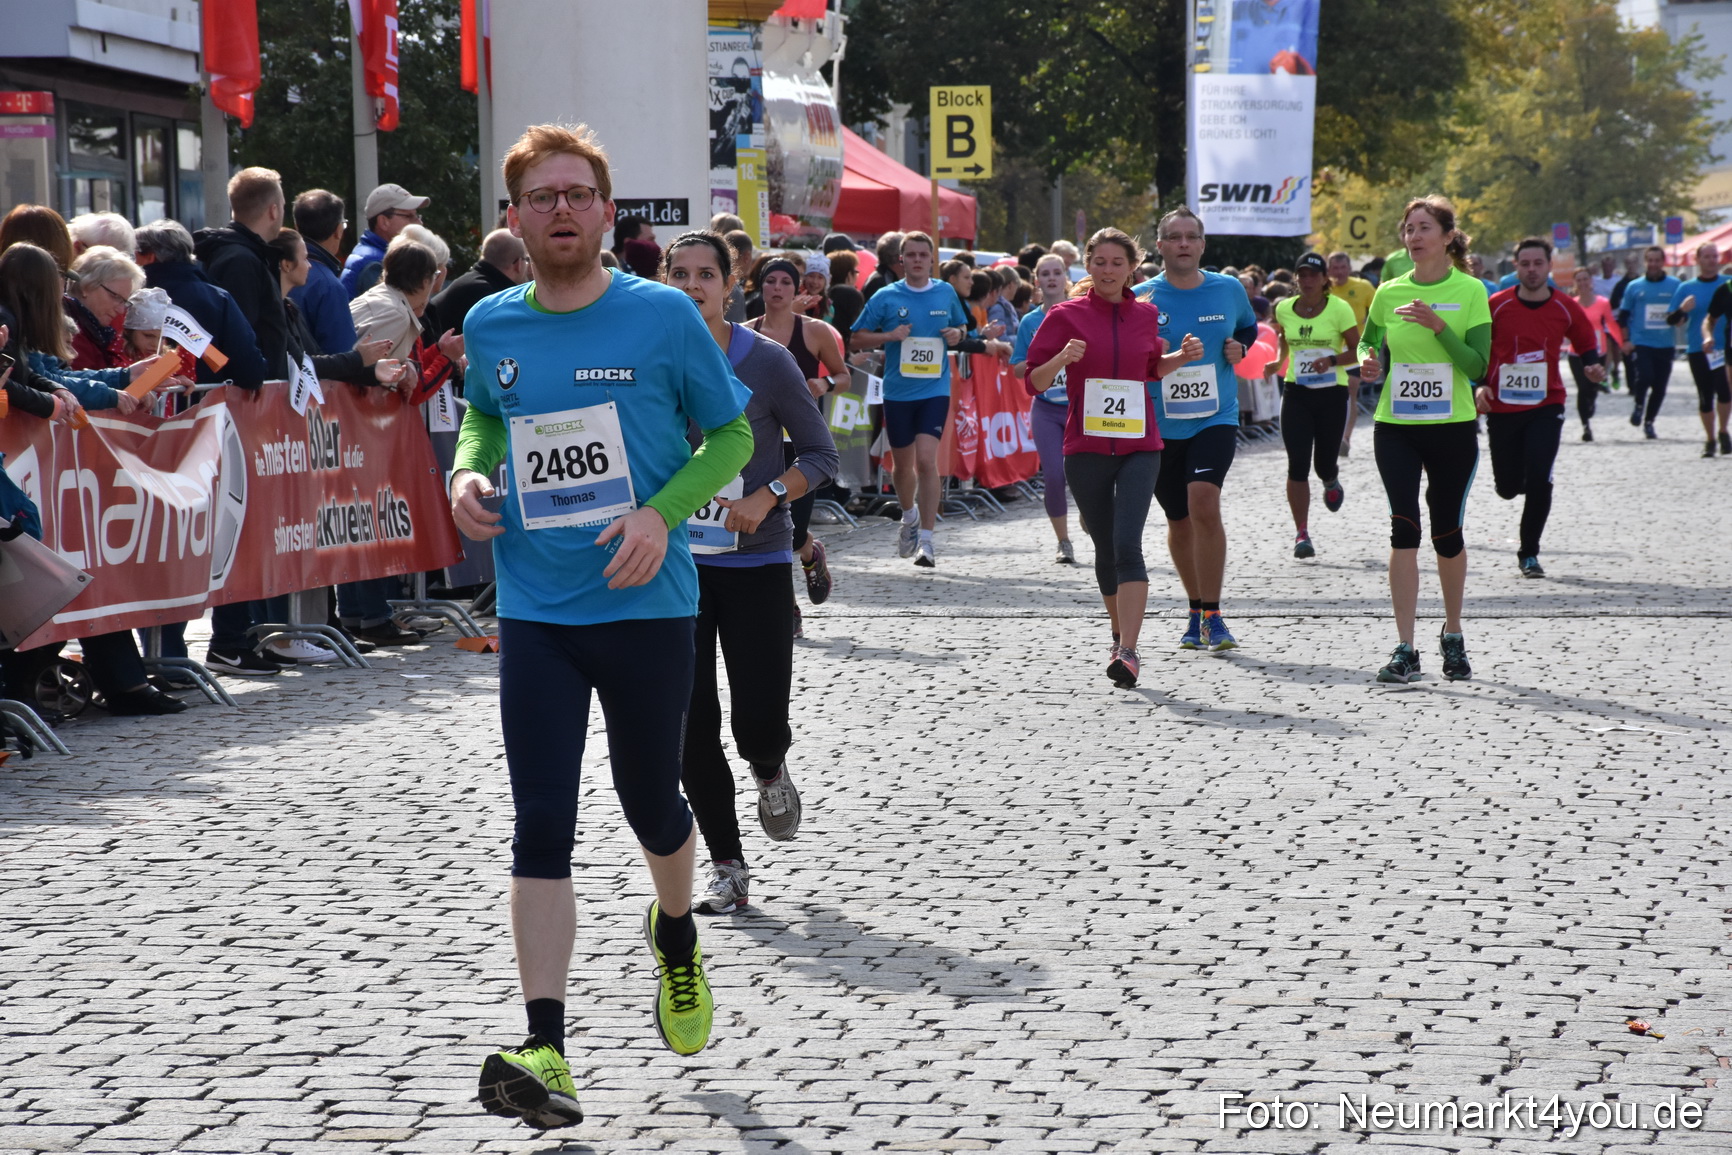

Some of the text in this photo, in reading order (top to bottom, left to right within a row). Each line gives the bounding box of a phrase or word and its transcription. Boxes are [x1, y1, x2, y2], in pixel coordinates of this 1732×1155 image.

[937, 90, 984, 107] Block
[946, 114, 976, 159] B
[1199, 183, 1272, 204] swn
[1349, 214, 1367, 240] C
[164, 315, 191, 335] swn
[1198, 314, 1226, 323] BOCK
[911, 350, 934, 363] 250
[574, 368, 636, 382] BOCK
[1506, 375, 1540, 389] 2410
[1170, 381, 1210, 400] 2932
[1400, 381, 1443, 398] 2305
[1104, 397, 1126, 415] 24
[544, 420, 584, 434] BOCK
[1102, 420, 1126, 428] Belinda
[308, 406, 340, 470] 80er
[527, 442, 609, 485] 2486
[550, 491, 597, 507] Thomas
[378, 485, 412, 539] Hits
[688, 496, 728, 521] 87
